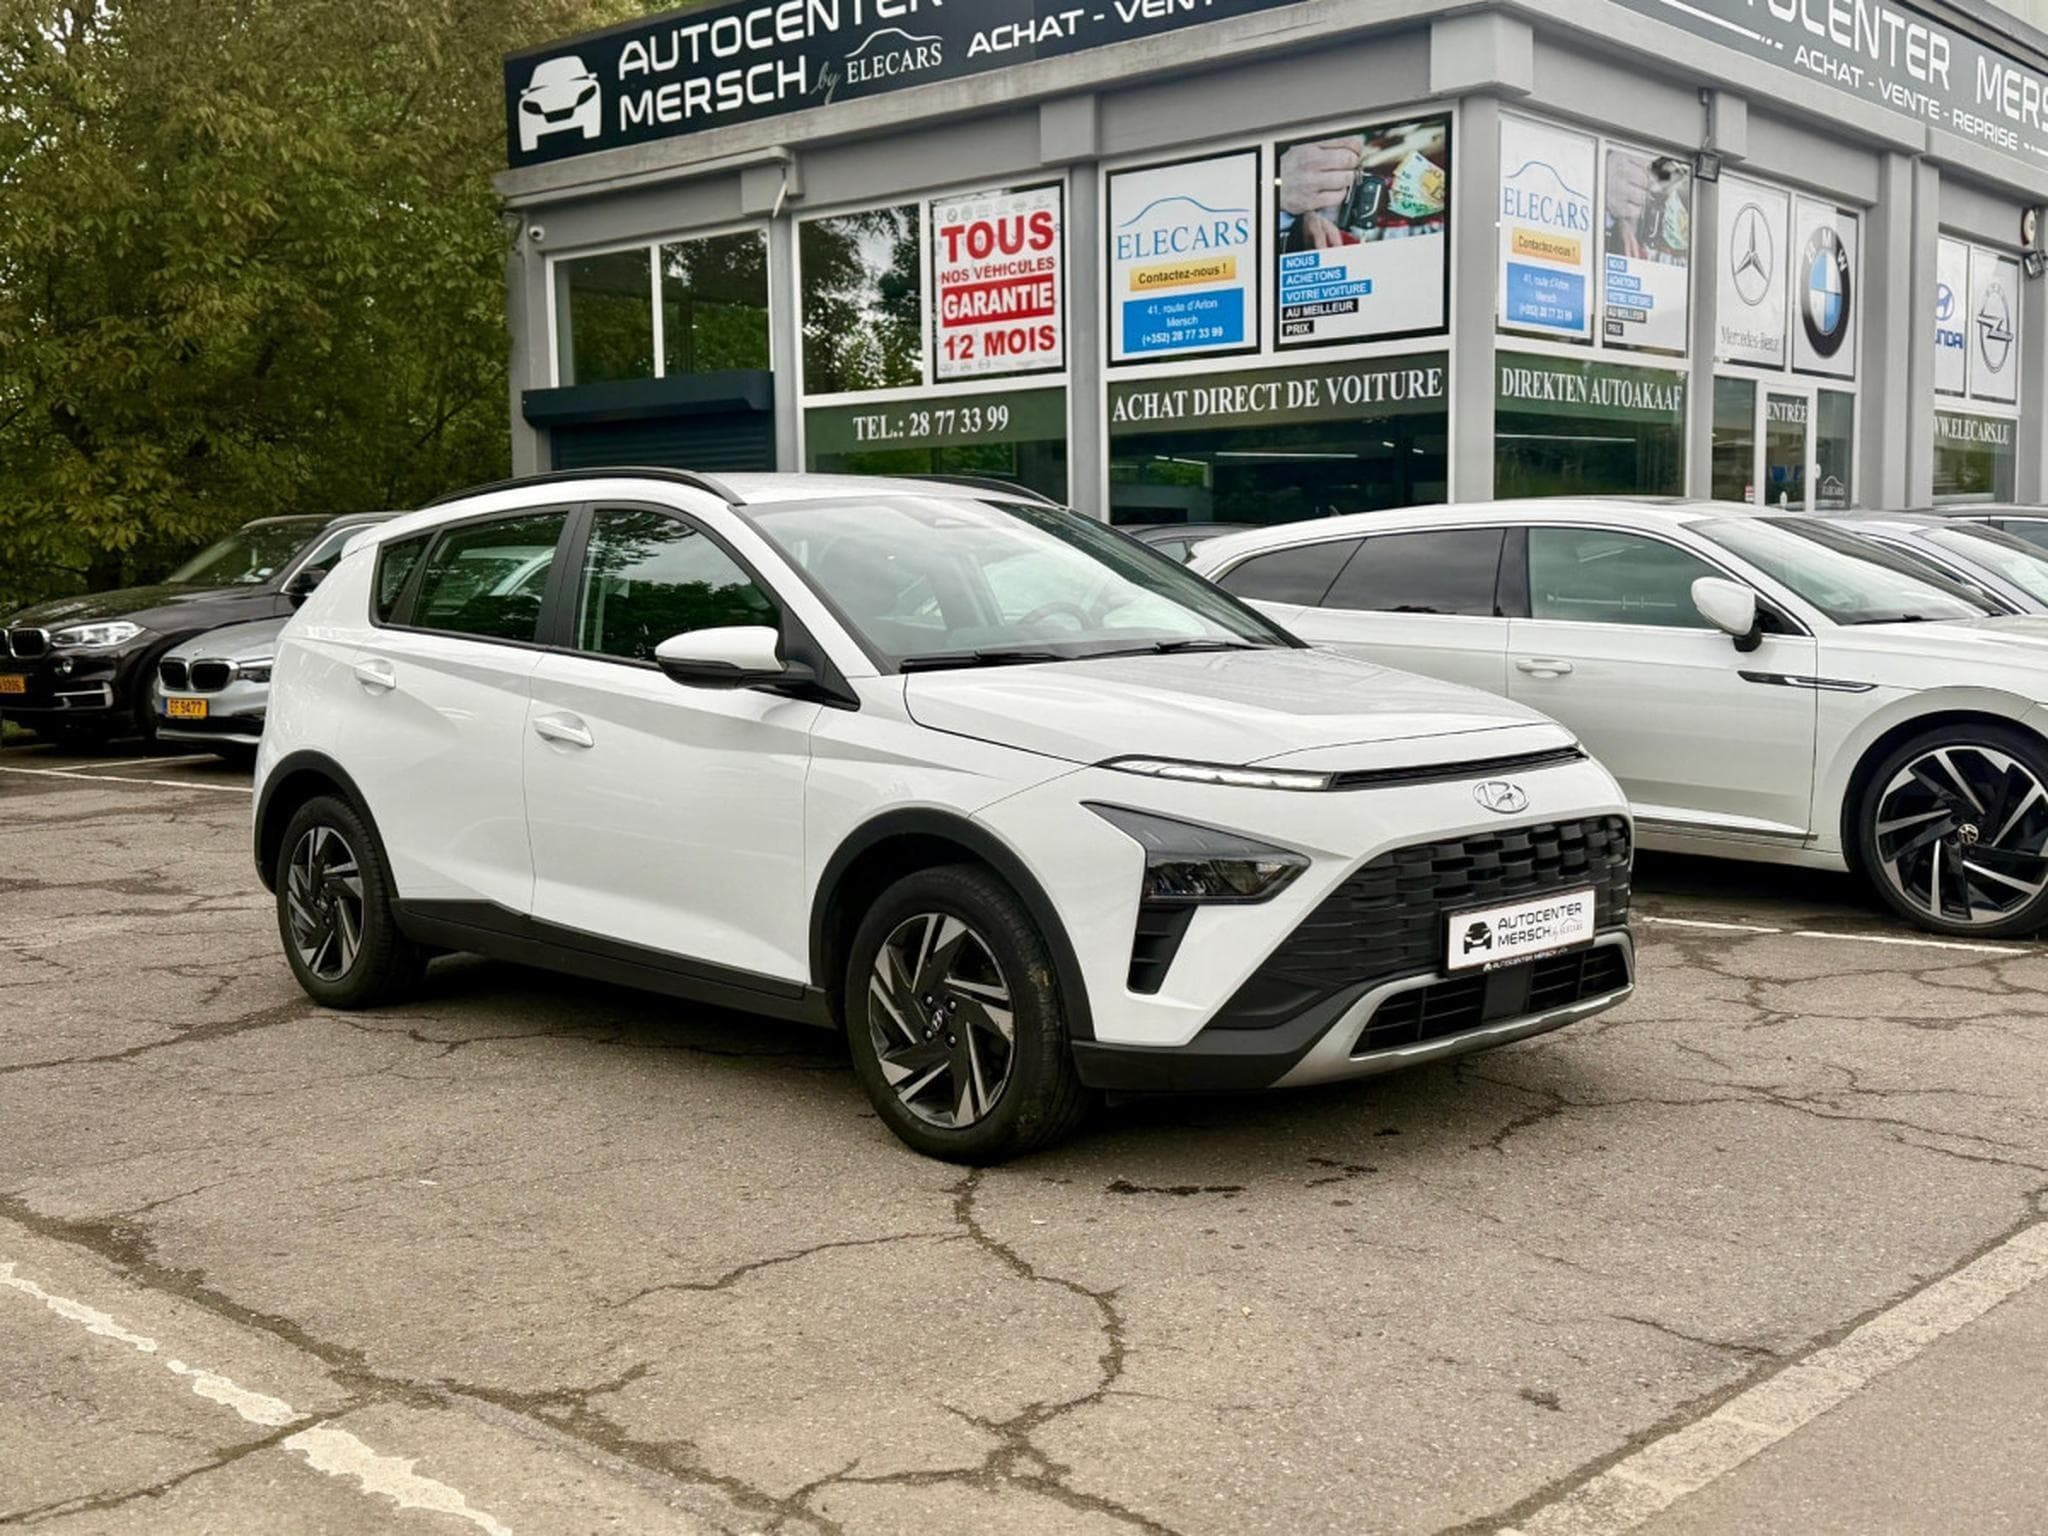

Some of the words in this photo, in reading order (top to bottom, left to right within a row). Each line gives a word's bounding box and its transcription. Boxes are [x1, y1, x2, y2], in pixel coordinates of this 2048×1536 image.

[966, 9, 1084, 58] ACHAT
[1113, 0, 1212, 23] VEN
[1747, 0, 1951, 91] CENTER
[620, 55, 807, 132] MERSCH
[810, 61, 841, 105] by
[847, 42, 942, 84] ELECARS
[1794, 45, 1865, 88] ACHAT
[1878, 77, 1940, 117] VENTE
[1952, 107, 2019, 151] REPRISE
[1503, 187, 1590, 233] ELECARS
[940, 211, 1054, 263] TOUS
[1117, 218, 1249, 260] ELECARS
[941, 269, 970, 284] NOS
[1138, 265, 1220, 284] Contactez-nous
[1286, 255, 1315, 268] NOUS
[1286, 270, 1342, 285] ACHETONS
[1286, 288, 1320, 301] VOTRE
[1321, 282, 1368, 297] VOITURE
[943, 281, 1054, 320] GARANTIE
[1163, 302, 1185, 314] route
[1286, 307, 1301, 318] AU
[1303, 301, 1354, 316] MEILLEUR
[1166, 315, 1199, 327] Mersch
[1172, 331, 1184, 341] 28
[1185, 329, 1196, 339] 77
[1211, 326, 1223, 337] 99
[1286, 323, 1310, 335] PRIX
[944, 334, 974, 361] 12
[984, 325, 1056, 357] MOIS
[1112, 390, 1188, 421] ACHAT
[1193, 382, 1282, 416] DIRECT
[1287, 379, 1320, 409] DE
[1326, 368, 1443, 405] VOITURE
[1502, 368, 1588, 402] DIREKTEN
[1591, 377, 1683, 411] AUTOAKAAF
[853, 414, 904, 440] TEL.:
[909, 411, 930, 437] 28
[935, 409, 955, 435] 77
[960, 407, 982, 433] 33
[987, 405, 1009, 432] 99
[1498, 902, 1583, 930] AUTOCENTER
[1498, 924, 1551, 947] MERSCH
